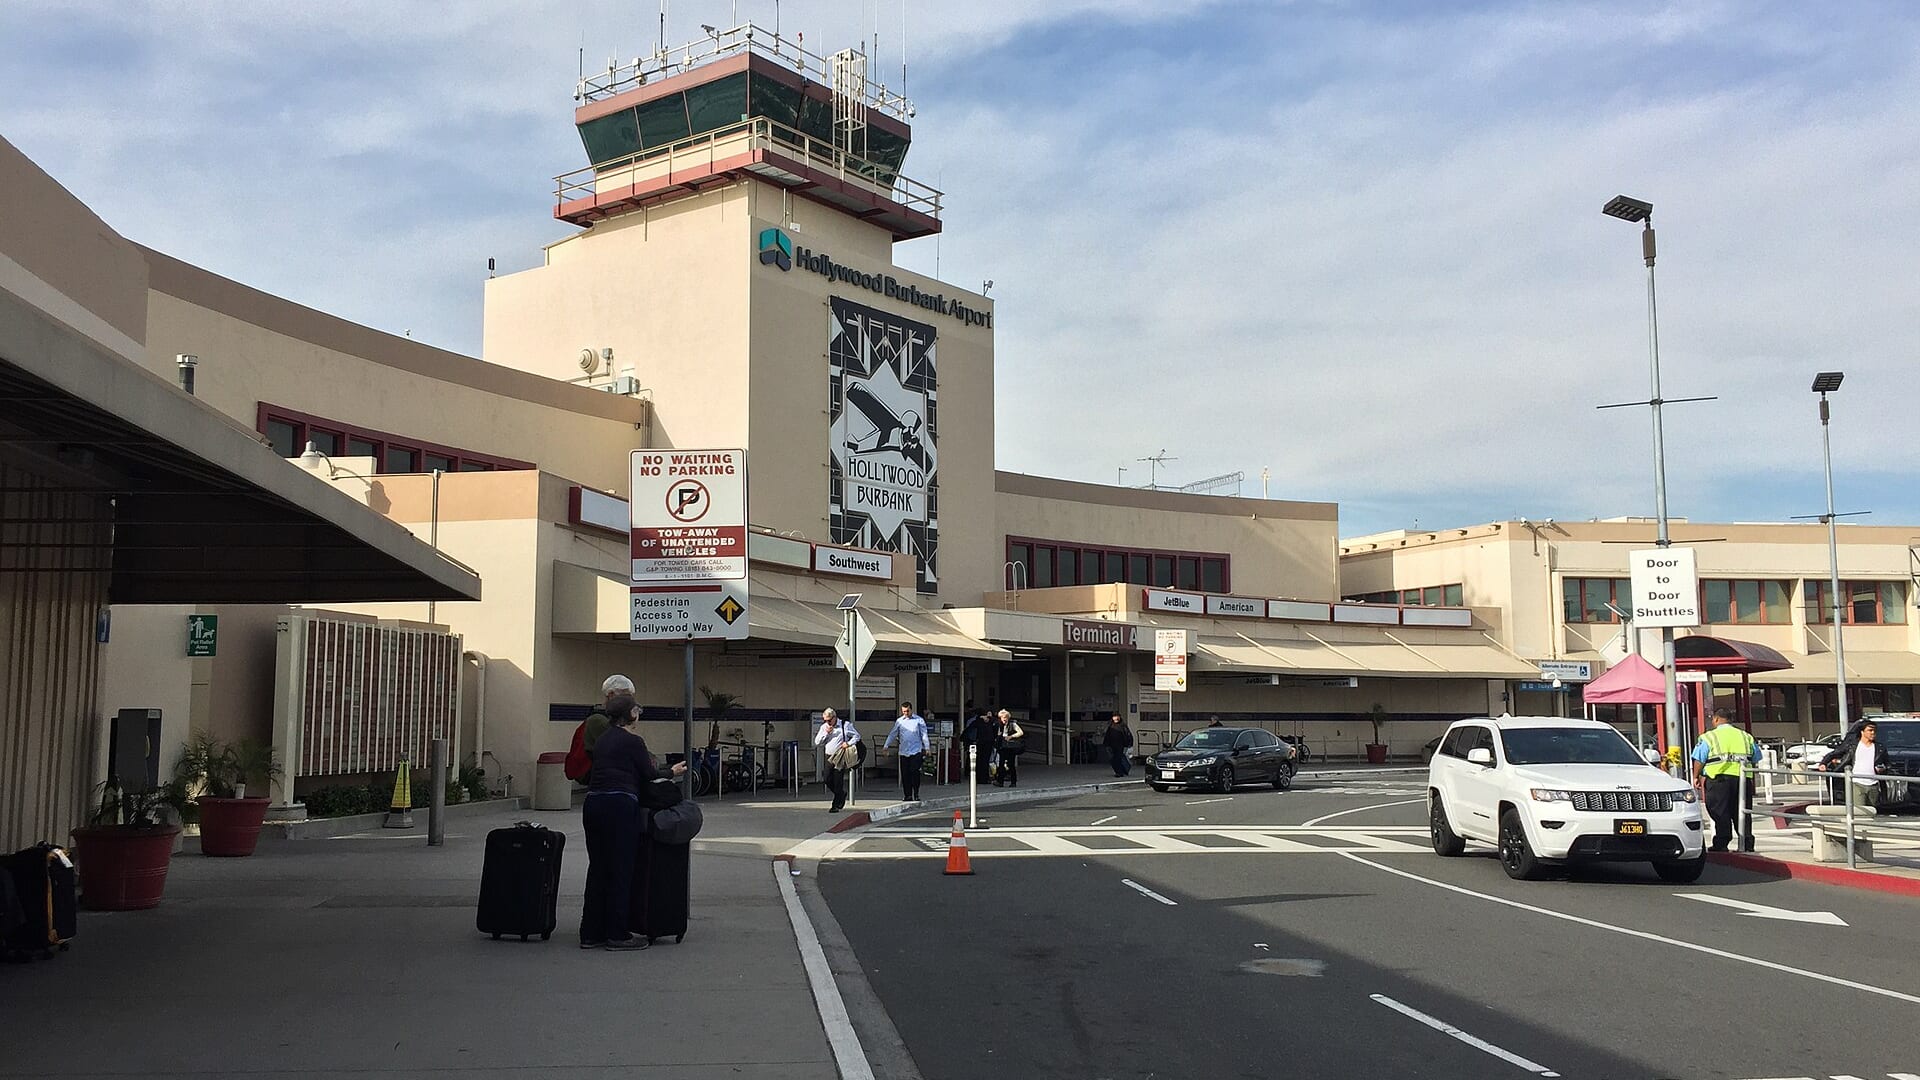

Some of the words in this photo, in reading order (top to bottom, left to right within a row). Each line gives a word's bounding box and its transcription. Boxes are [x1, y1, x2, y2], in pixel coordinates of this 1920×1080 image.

[796, 246, 883, 293] Hollywood
[884, 276, 948, 315] Burbank
[948, 298, 992, 329] Airport
[642, 456, 663, 464] NO
[671, 454, 732, 464] WAITING
[640, 466, 661, 476] NO
[669, 465, 735, 476] PARKING
[849, 457, 924, 488] HOLLYWOOD
[858, 486, 912, 512] BURBANK
[658, 528, 718, 537] TOW-AWAY
[662, 538, 736, 547] UNATTENDED
[829, 554, 880, 572] Southwest
[1646, 560, 1678, 568] Door
[1648, 592, 1680, 600] Door
[634, 598, 690, 607] Pedestrian
[1164, 596, 1190, 608] JetBlue
[1219, 601, 1254, 612] American
[634, 610, 672, 620] Access
[677, 610, 689, 619] To
[1636, 607, 1694, 617] Shuttles
[634, 623, 688, 634] Hollywood
[692, 622, 713, 632] Way
[1064, 622, 1123, 645] Terminal
